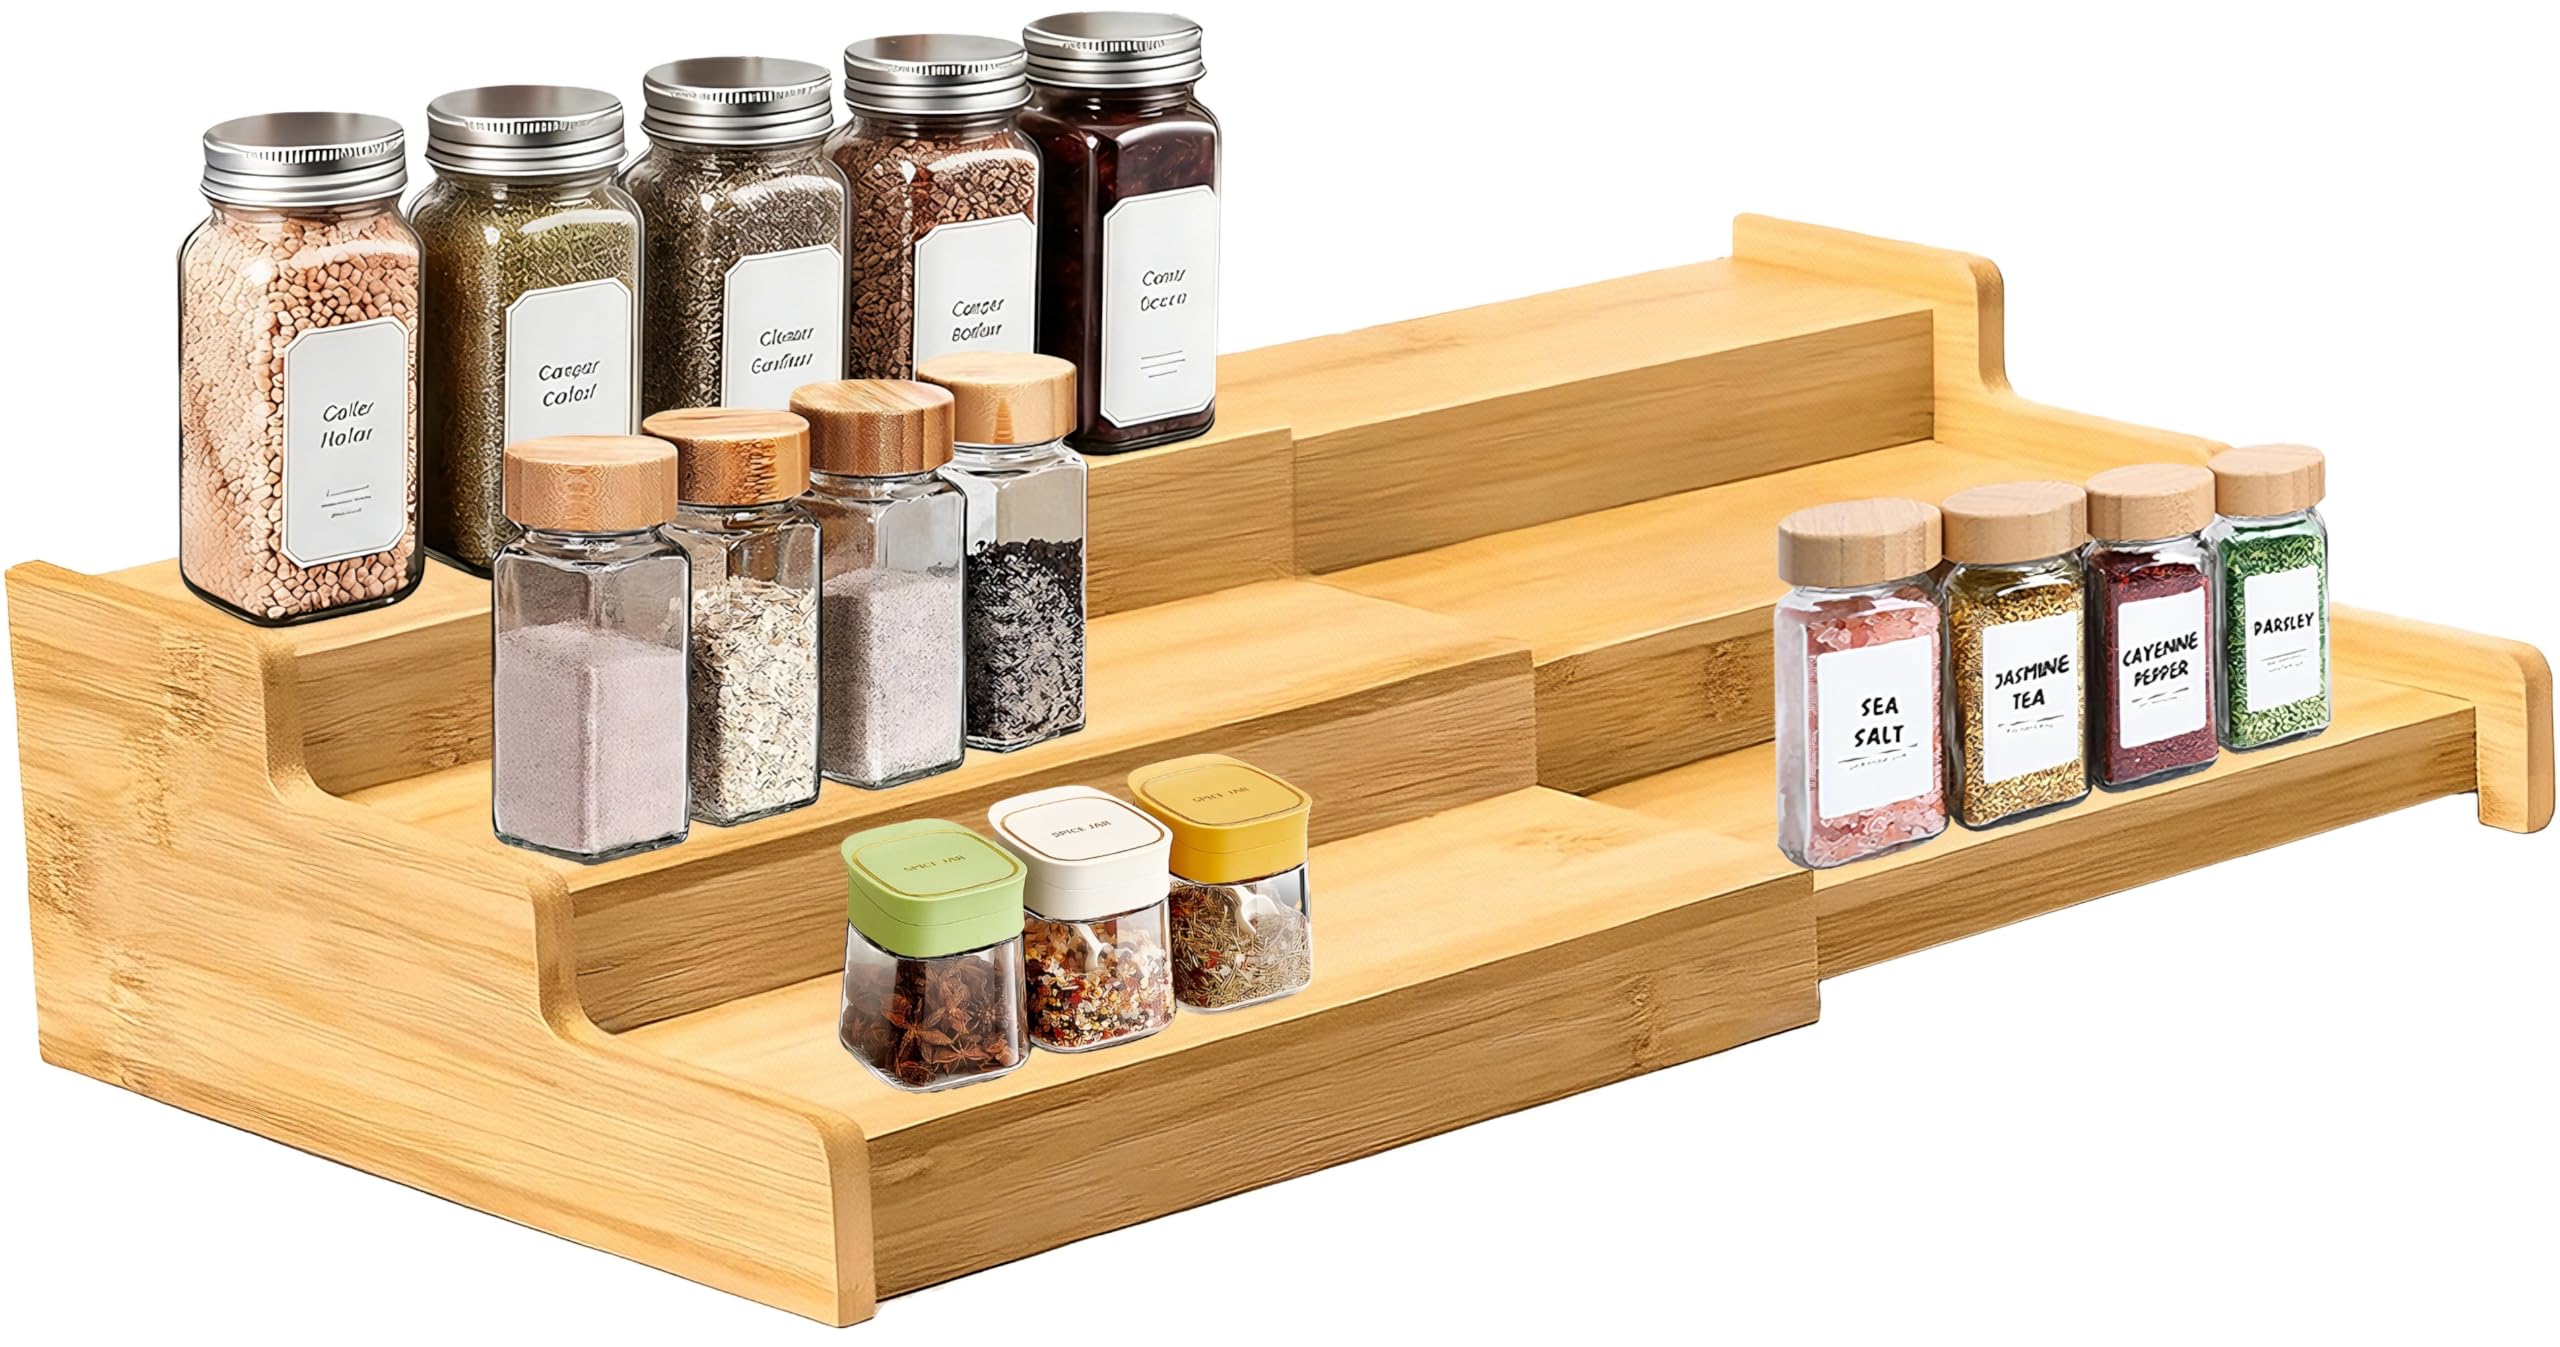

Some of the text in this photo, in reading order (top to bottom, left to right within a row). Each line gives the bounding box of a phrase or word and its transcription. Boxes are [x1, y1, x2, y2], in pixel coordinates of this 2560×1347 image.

[2253, 611, 2315, 637] PARSLEY
[2122, 630, 2199, 668] CAYENNE
[1994, 654, 2071, 690] JASMINE
[2133, 659, 2189, 688] PEPPER
[1861, 696, 1899, 717] SEA
[2012, 688, 2046, 710] TEA
[1853, 724, 1905, 748] SALT
[1051, 819, 1112, 839] SPICE JAR
